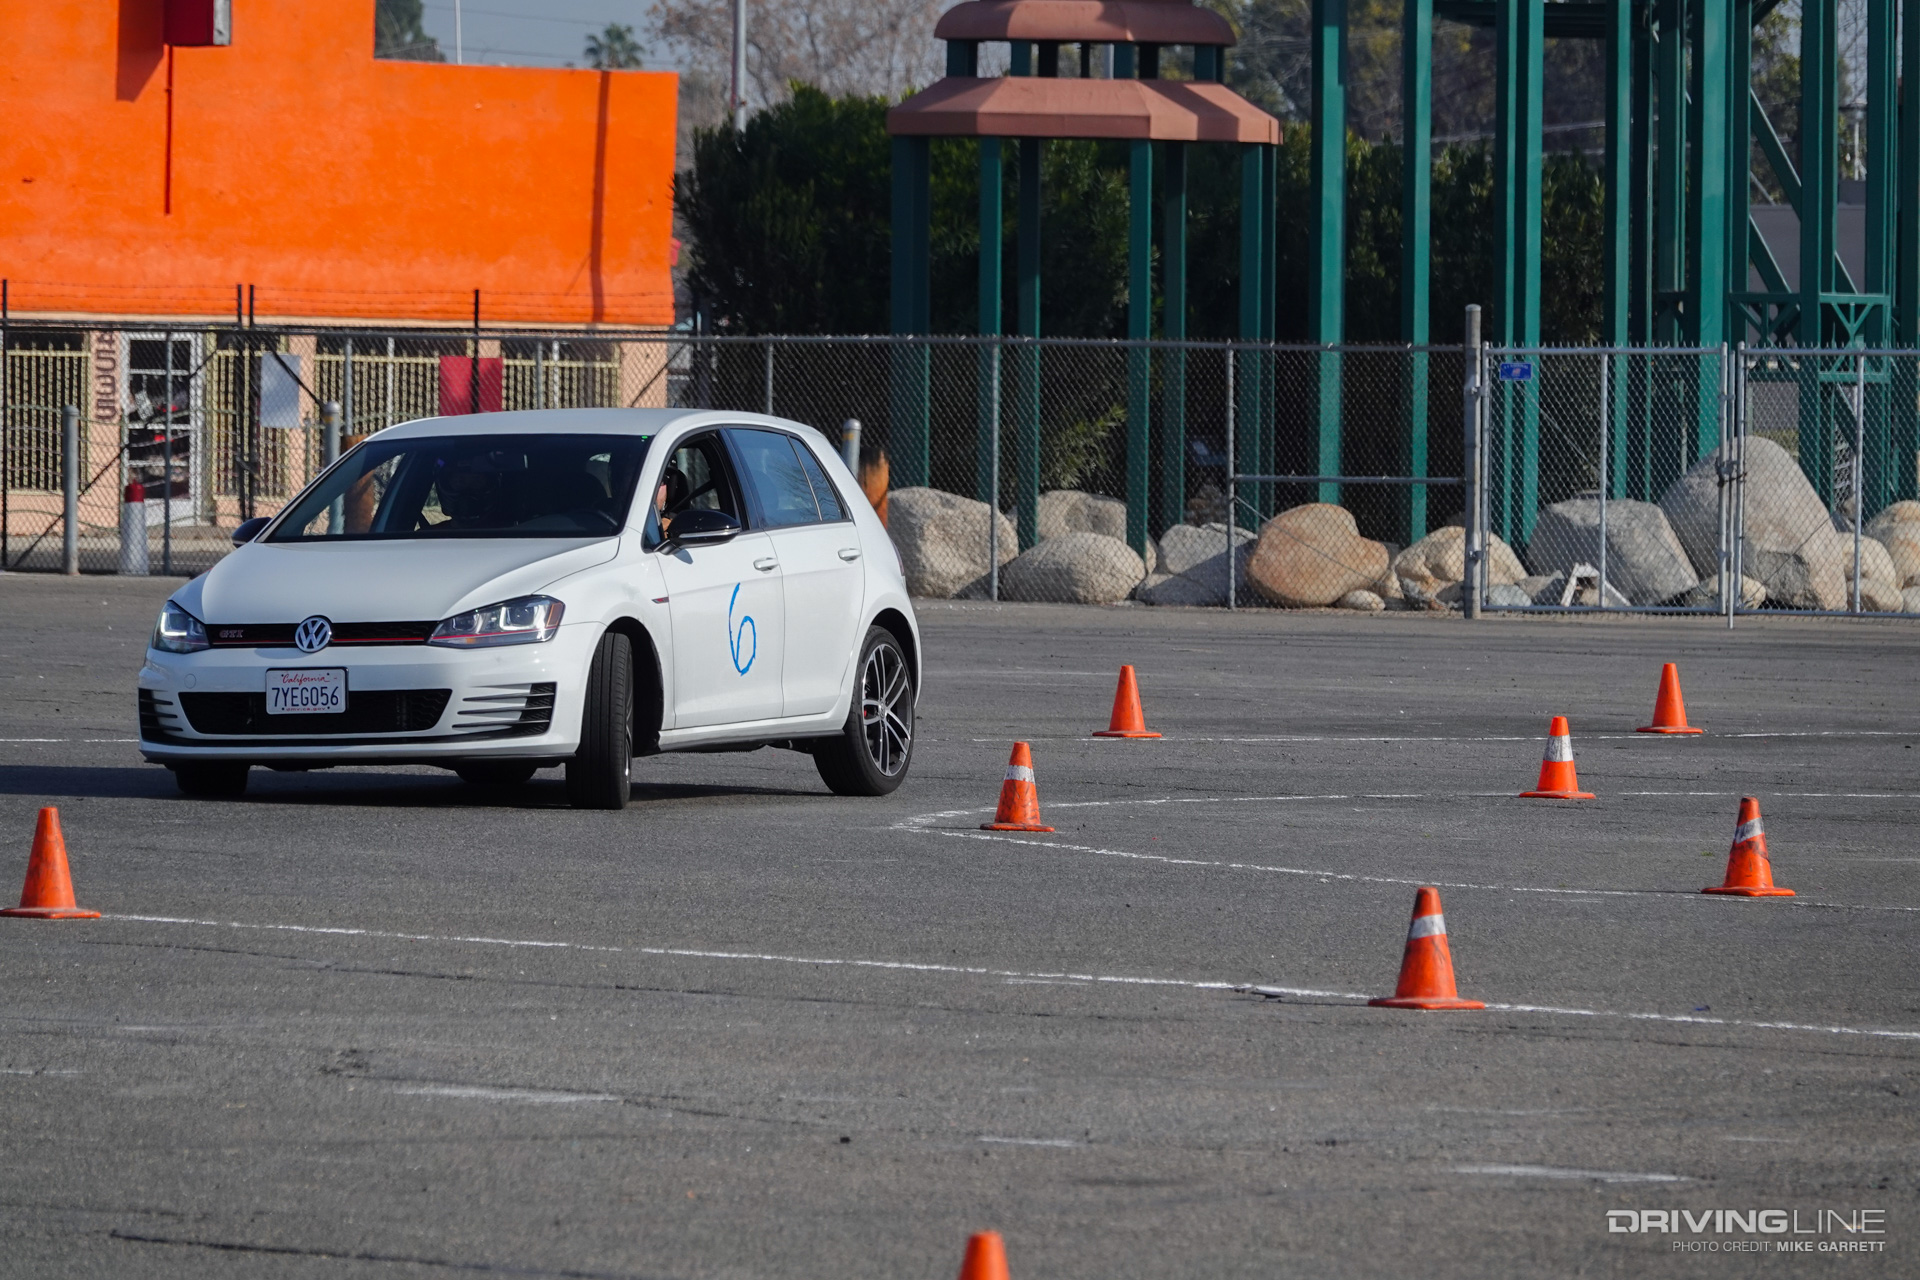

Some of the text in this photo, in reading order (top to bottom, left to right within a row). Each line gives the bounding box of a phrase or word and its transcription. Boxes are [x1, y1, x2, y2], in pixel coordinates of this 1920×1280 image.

[219, 629, 244, 639] GTI
[728, 582, 757, 677] 6
[282, 673, 330, 686] California
[271, 686, 339, 708] 7YEG056
